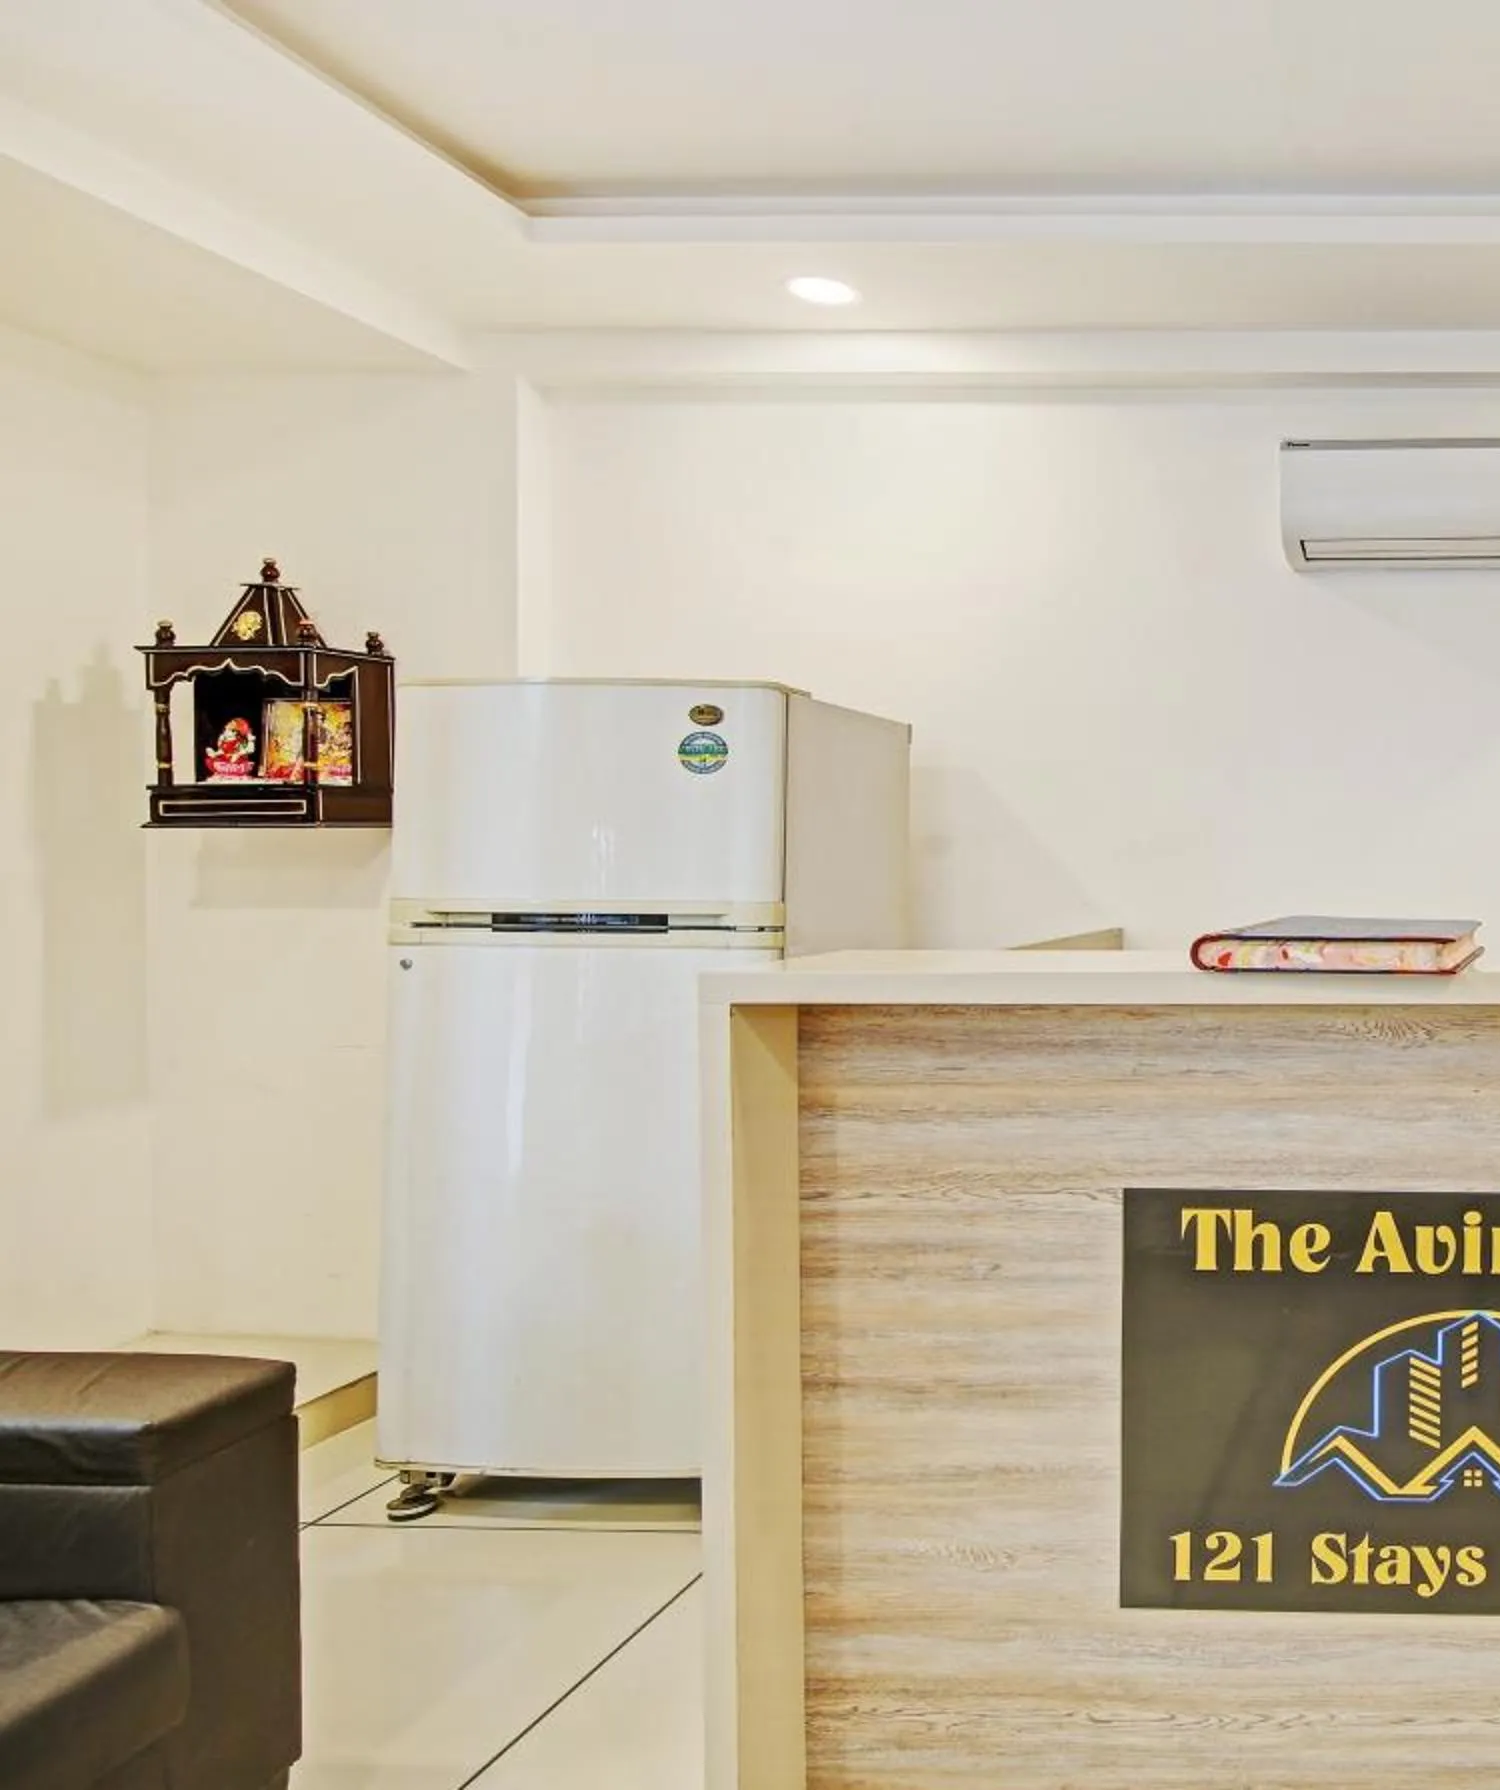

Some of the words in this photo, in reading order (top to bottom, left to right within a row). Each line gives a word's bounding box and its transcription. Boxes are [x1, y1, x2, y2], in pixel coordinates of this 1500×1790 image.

[1181, 1208, 1331, 1273] The
[1171, 1531, 1273, 1583] 121
[1311, 1532, 1487, 1598] Stays
